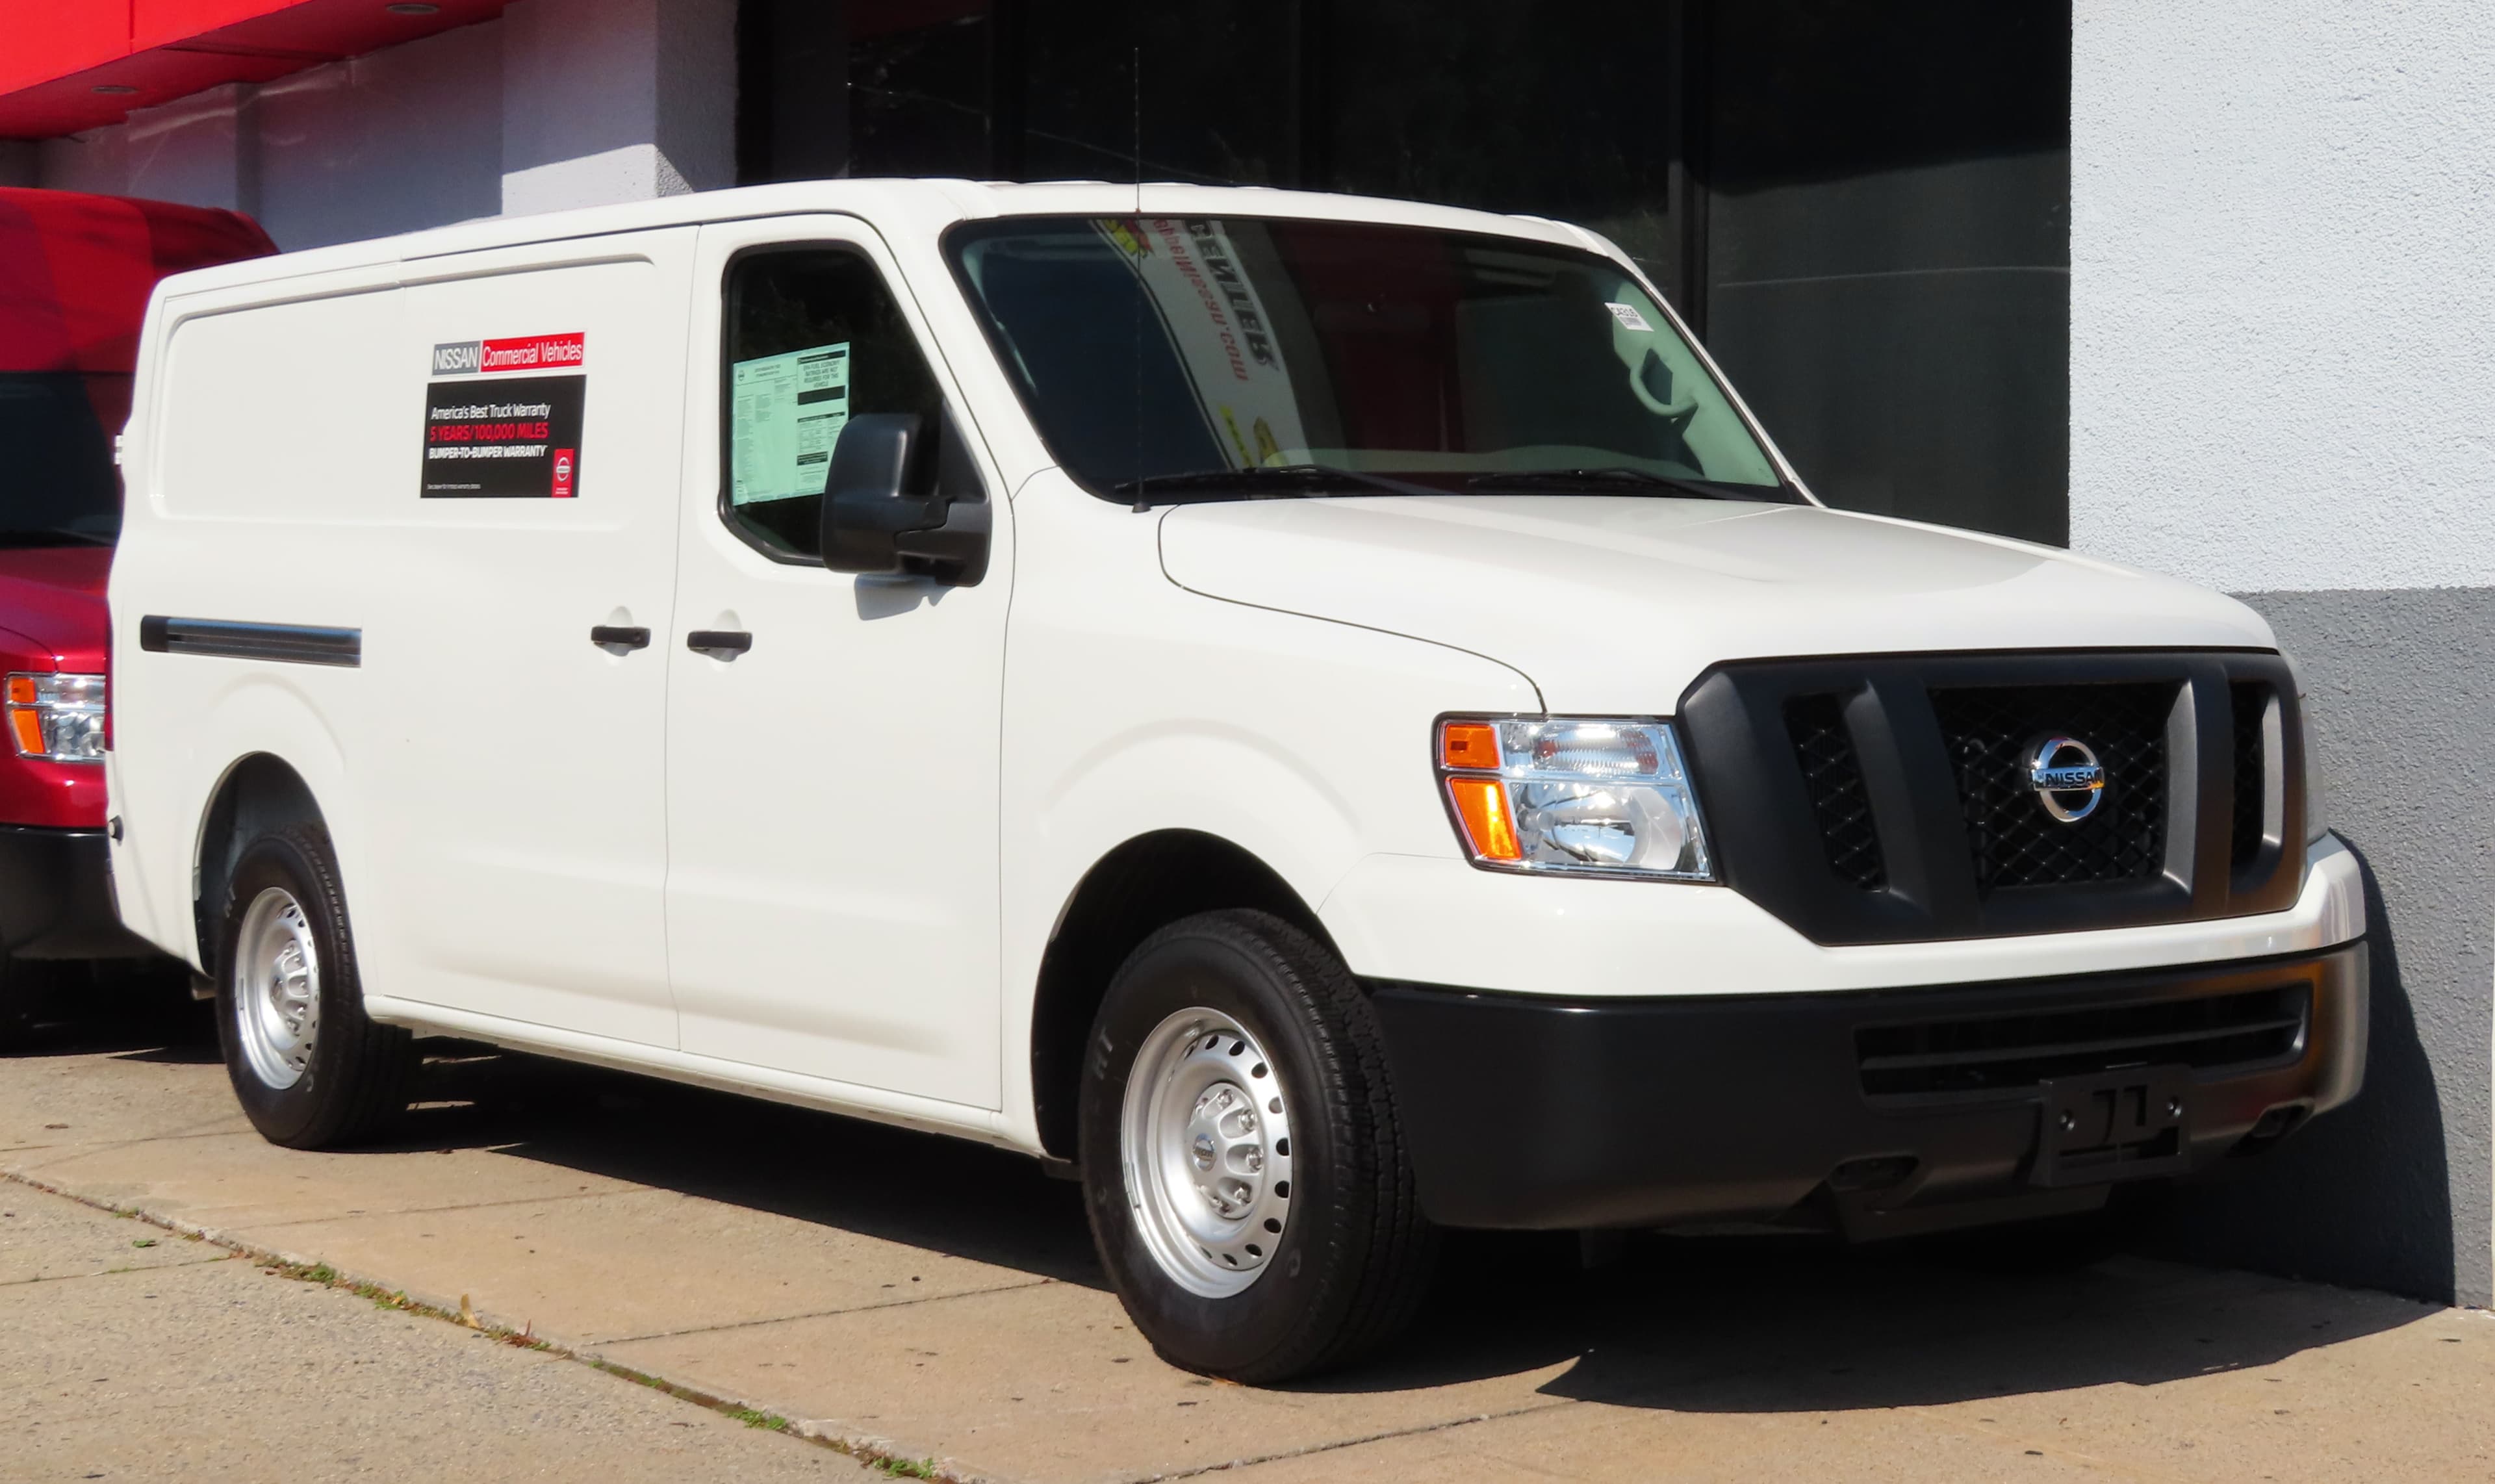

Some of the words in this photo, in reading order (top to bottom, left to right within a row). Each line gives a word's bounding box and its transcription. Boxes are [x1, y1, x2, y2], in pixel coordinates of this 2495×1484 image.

[435, 347, 479, 370] NISSAN
[483, 342, 539, 367] Commercial
[541, 340, 583, 363] Vehicles
[431, 405, 469, 420] America's
[470, 404, 489, 418] Best
[489, 403, 513, 418] Truck
[513, 402, 551, 419] Warranty
[430, 426, 437, 441] 5
[439, 423, 516, 442] YEARS/100,000
[517, 422, 549, 439] MILES
[429, 445, 504, 459] BUMPER-TO-BUMPER
[504, 444, 548, 457] WARRANTY
